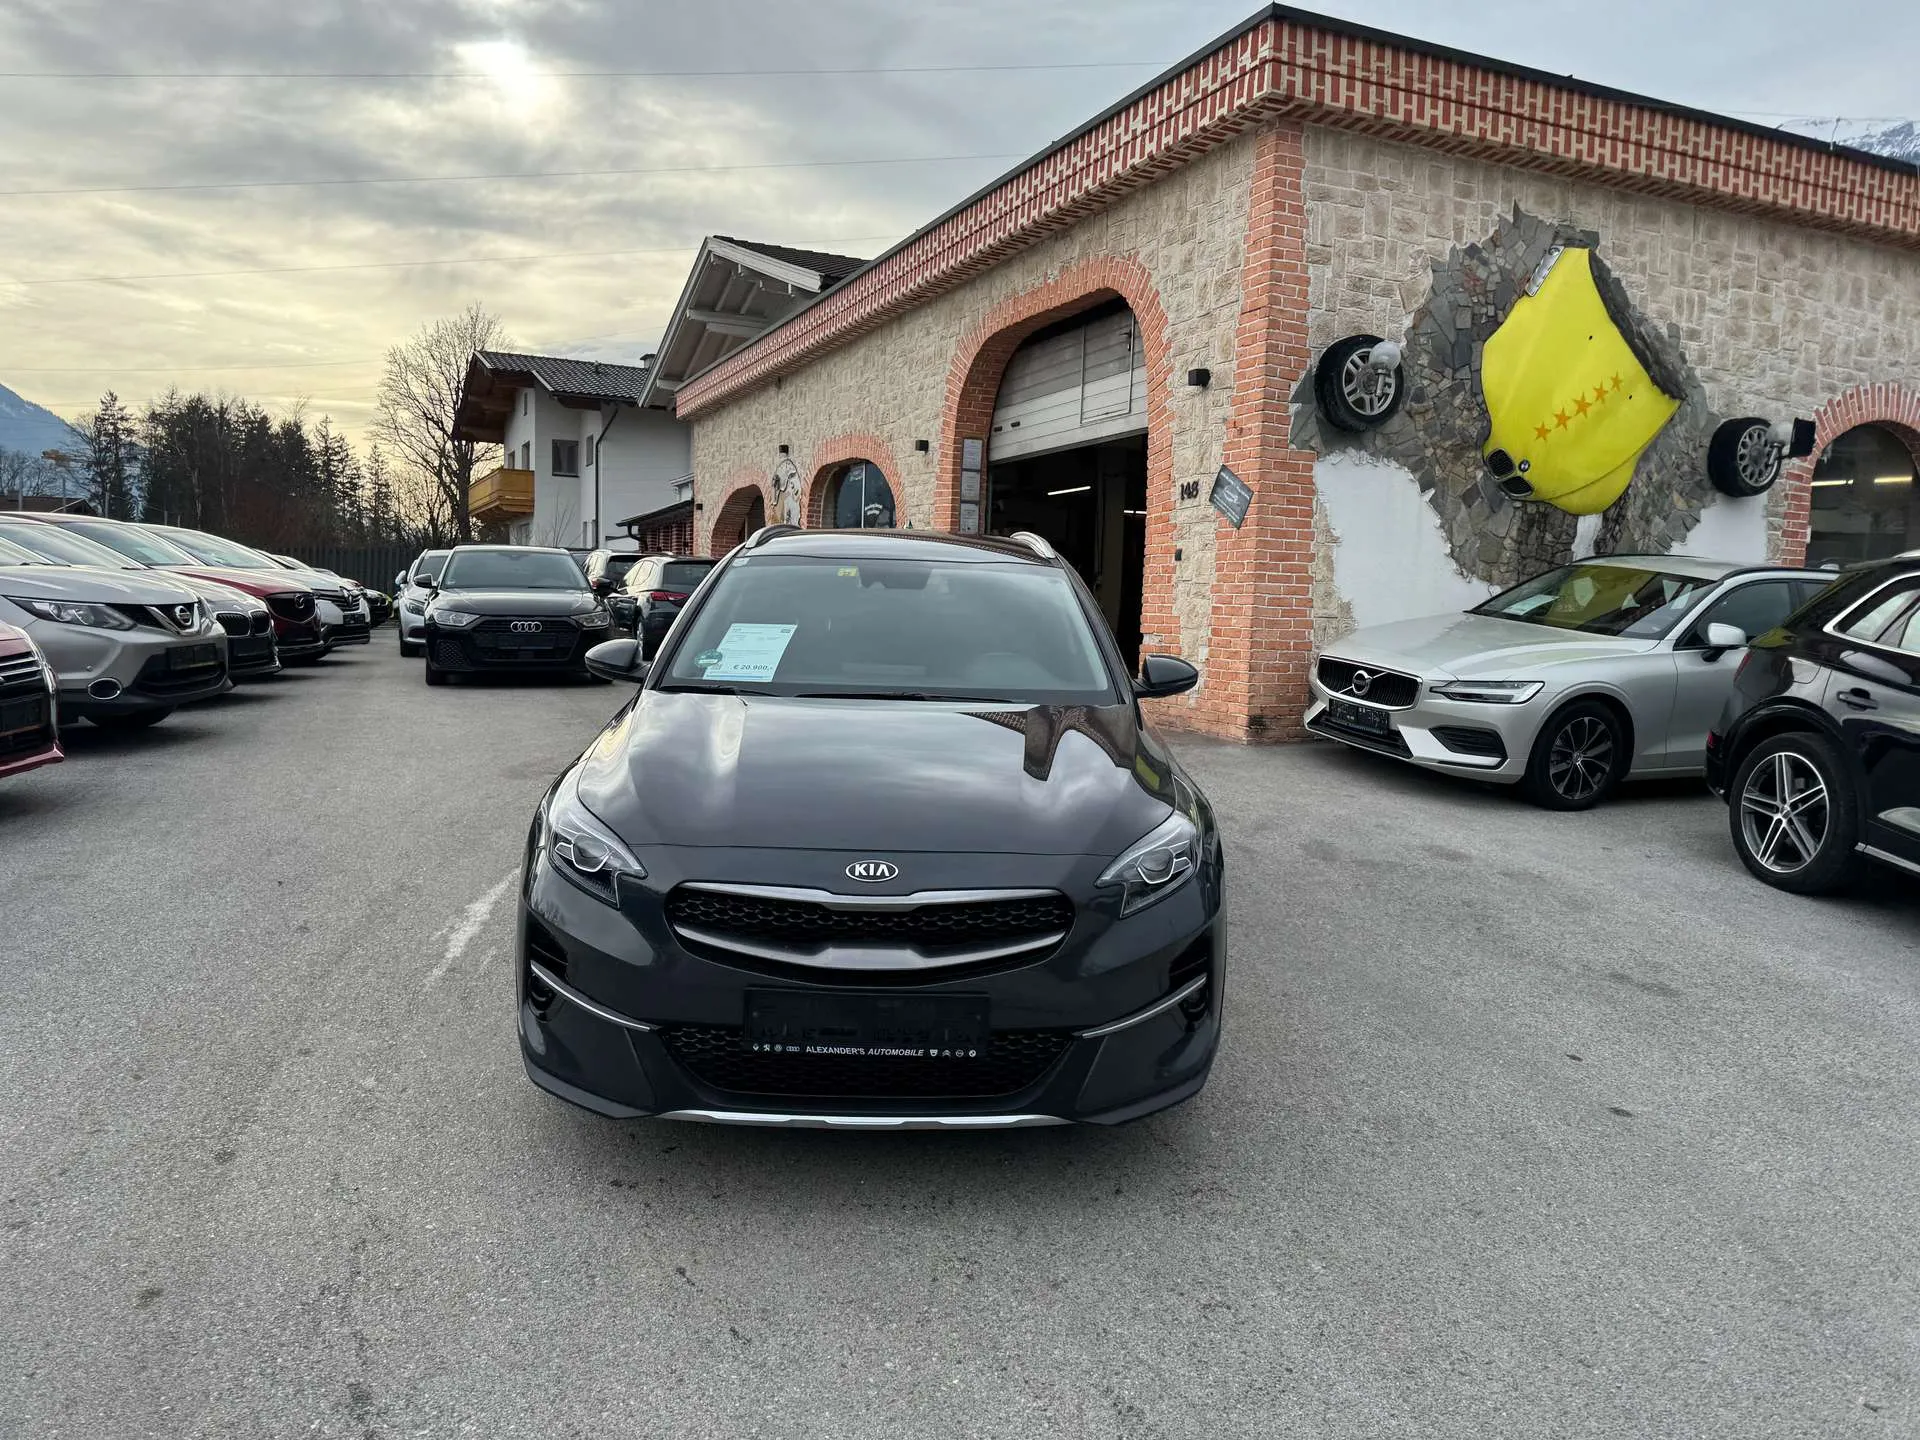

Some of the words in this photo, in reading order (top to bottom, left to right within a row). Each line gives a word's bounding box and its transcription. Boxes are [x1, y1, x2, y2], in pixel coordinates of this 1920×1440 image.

[1180, 480, 1199, 501] 148
[854, 863, 890, 877] KIA
[806, 1046, 865, 1055] ALEXANDER'S
[868, 1048, 925, 1056] AUTOMOBILE
